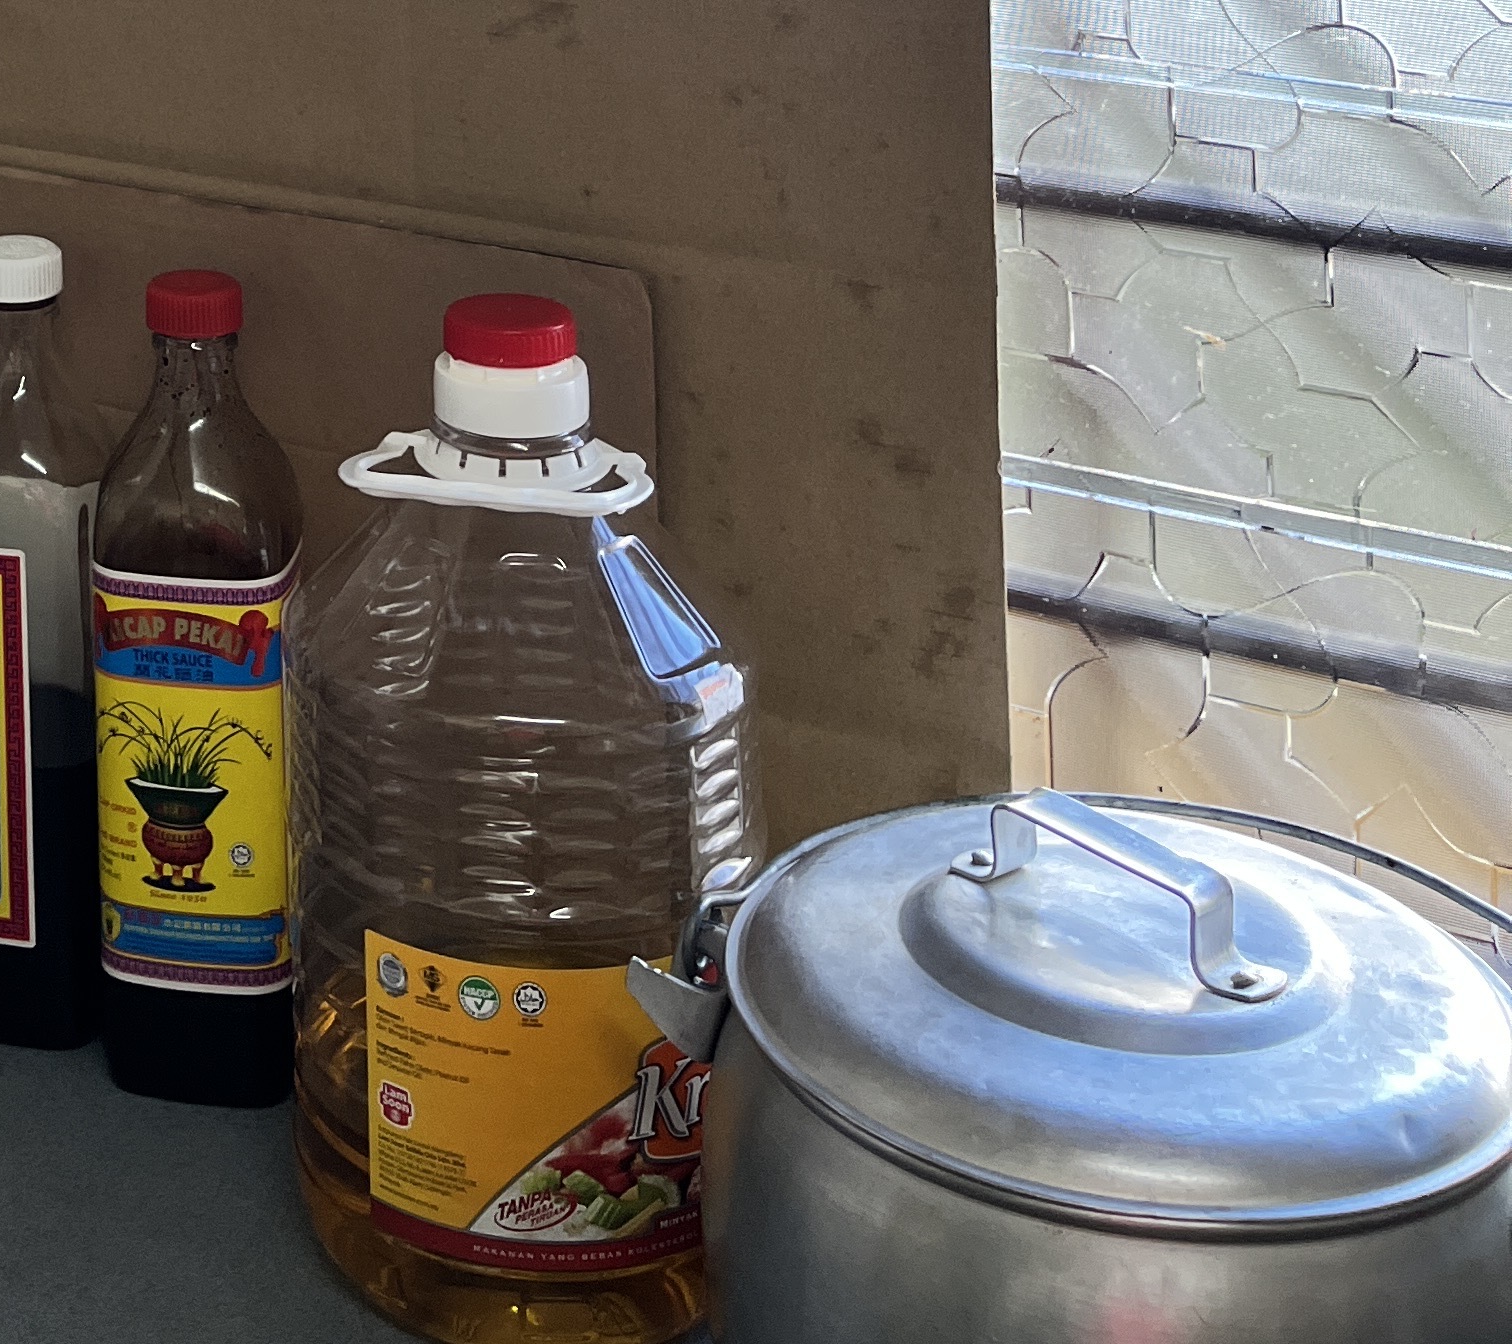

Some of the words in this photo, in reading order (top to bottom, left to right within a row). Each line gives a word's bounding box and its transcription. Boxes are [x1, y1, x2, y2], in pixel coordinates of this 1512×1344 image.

[133, 648, 169, 663] THICK
[172, 653, 213, 668] SAUCE
[463, 986, 496, 999] HACCP
[384, 1084, 407, 1102] Lam
[382, 1094, 410, 1113] Soon
[498, 1188, 552, 1221] TANPA
[515, 1202, 554, 1225] PERASA
[473, 1244, 534, 1260] MAKANAN
[541, 1253, 575, 1261] YANG
[581, 1251, 622, 1261] BEBAS
